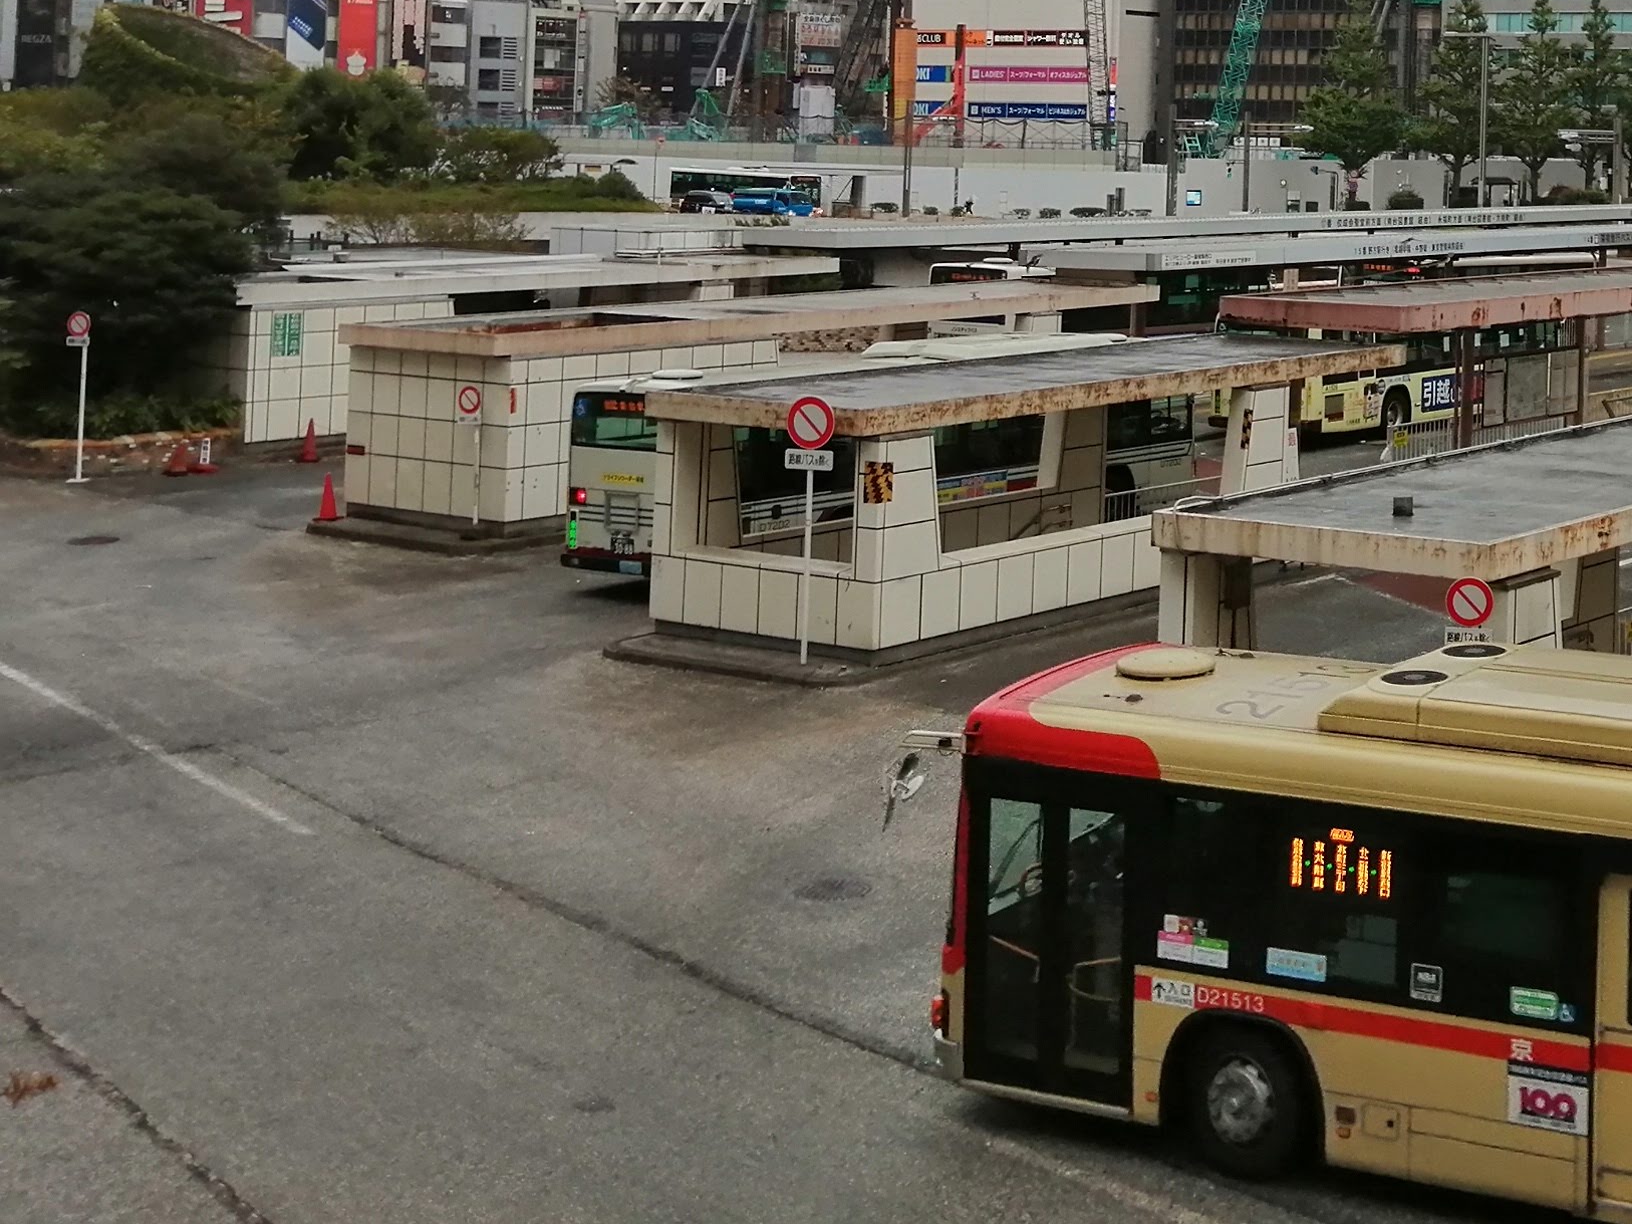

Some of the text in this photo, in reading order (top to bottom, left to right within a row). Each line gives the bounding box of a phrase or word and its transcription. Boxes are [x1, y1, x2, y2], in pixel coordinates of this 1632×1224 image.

[788, 453, 831, 468] 路線バスを除く
[1168, 981, 1192, 997] 入口
[1197, 987, 1265, 1014] D21513
[1511, 1038, 1534, 1062] 京
[1519, 1086, 1578, 1120] 100
